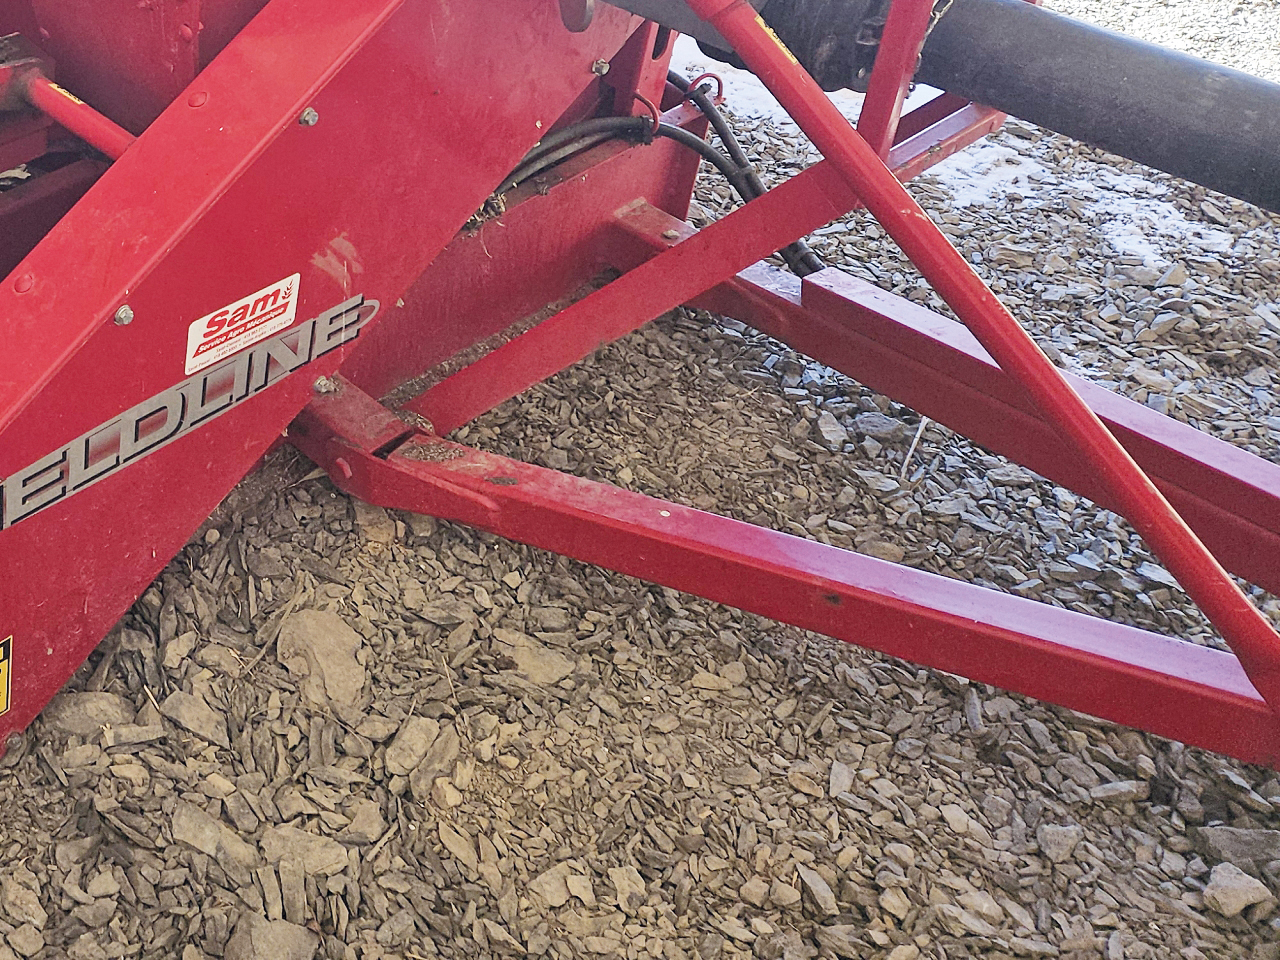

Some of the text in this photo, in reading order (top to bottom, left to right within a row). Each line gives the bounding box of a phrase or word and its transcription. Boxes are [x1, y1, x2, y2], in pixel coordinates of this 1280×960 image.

[203, 288, 281, 338] Sam
[197, 335, 227, 353] Service
[227, 326, 245, 340] Agro
